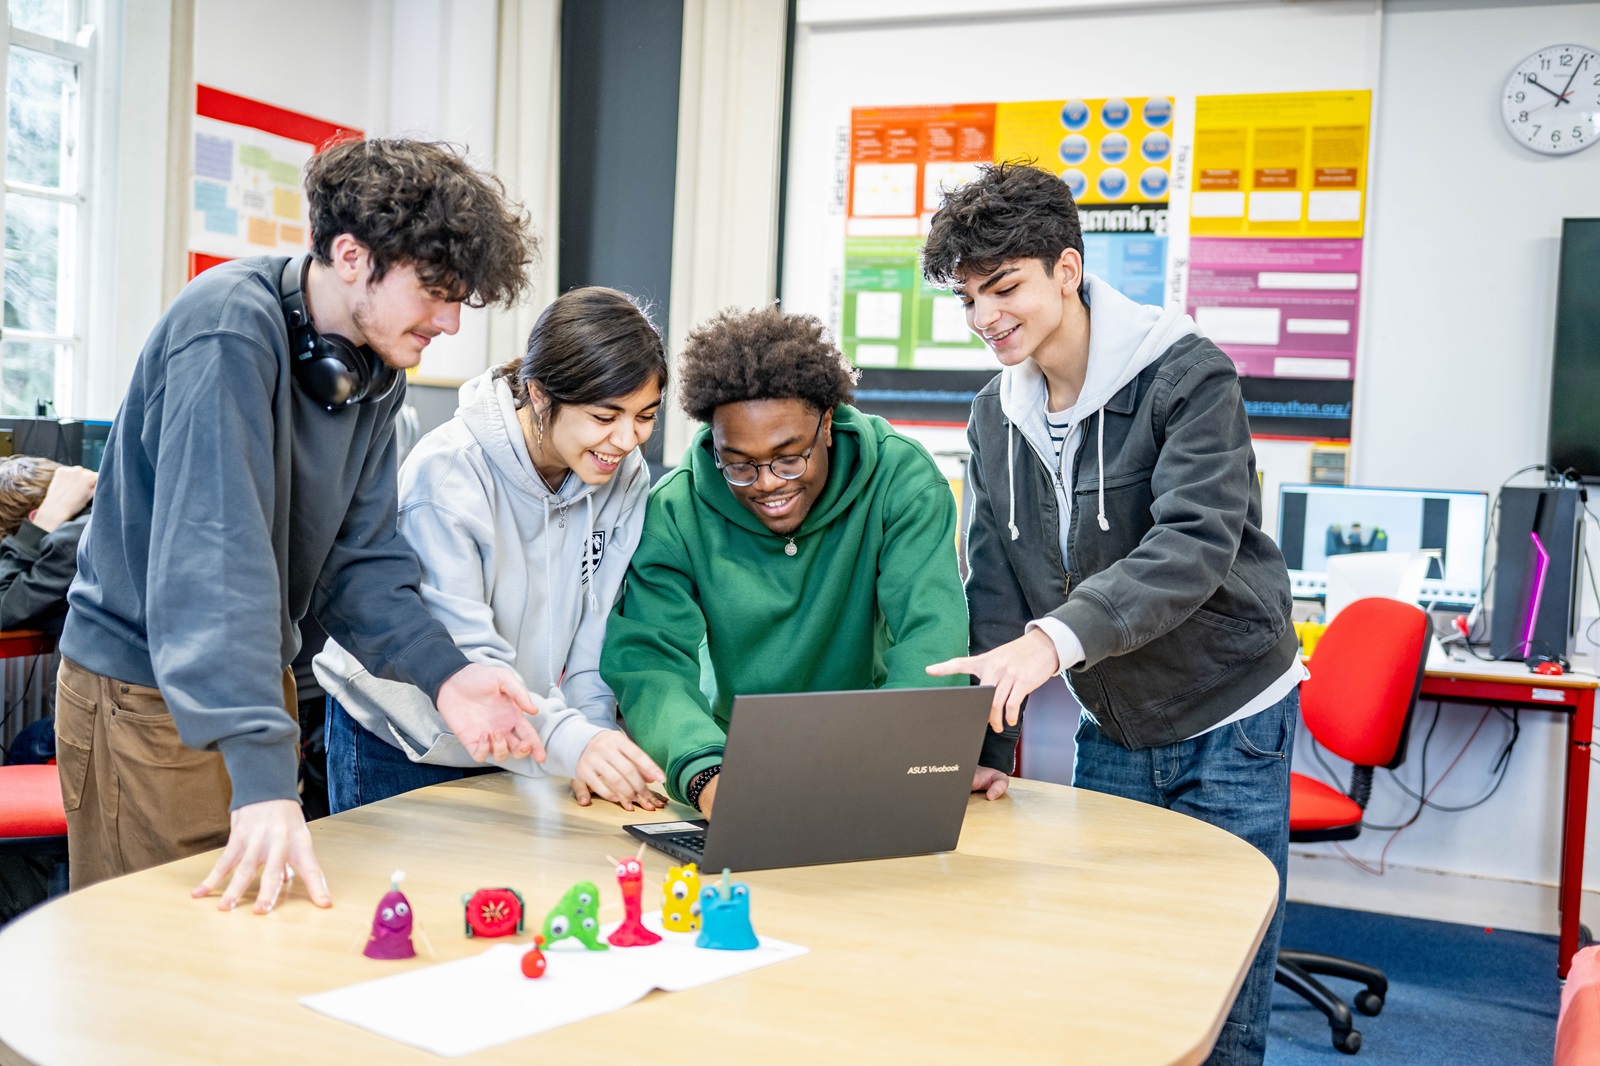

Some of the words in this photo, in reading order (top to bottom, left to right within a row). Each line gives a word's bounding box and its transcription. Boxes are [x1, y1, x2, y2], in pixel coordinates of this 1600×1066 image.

[1541, 59, 1551, 70] 11
[1559, 54, 1573, 66] 12
[1583, 60, 1589, 71] 1
[1522, 72, 1537, 84] 10
[1515, 91, 1525, 103] 9
[1519, 110, 1528, 122] 8
[1532, 125, 1542, 137] 7
[1551, 130, 1561, 142] 6
[1572, 126, 1581, 138] 5
[907, 766, 927, 774] ASUS
[929, 764, 959, 773] Vivobook
